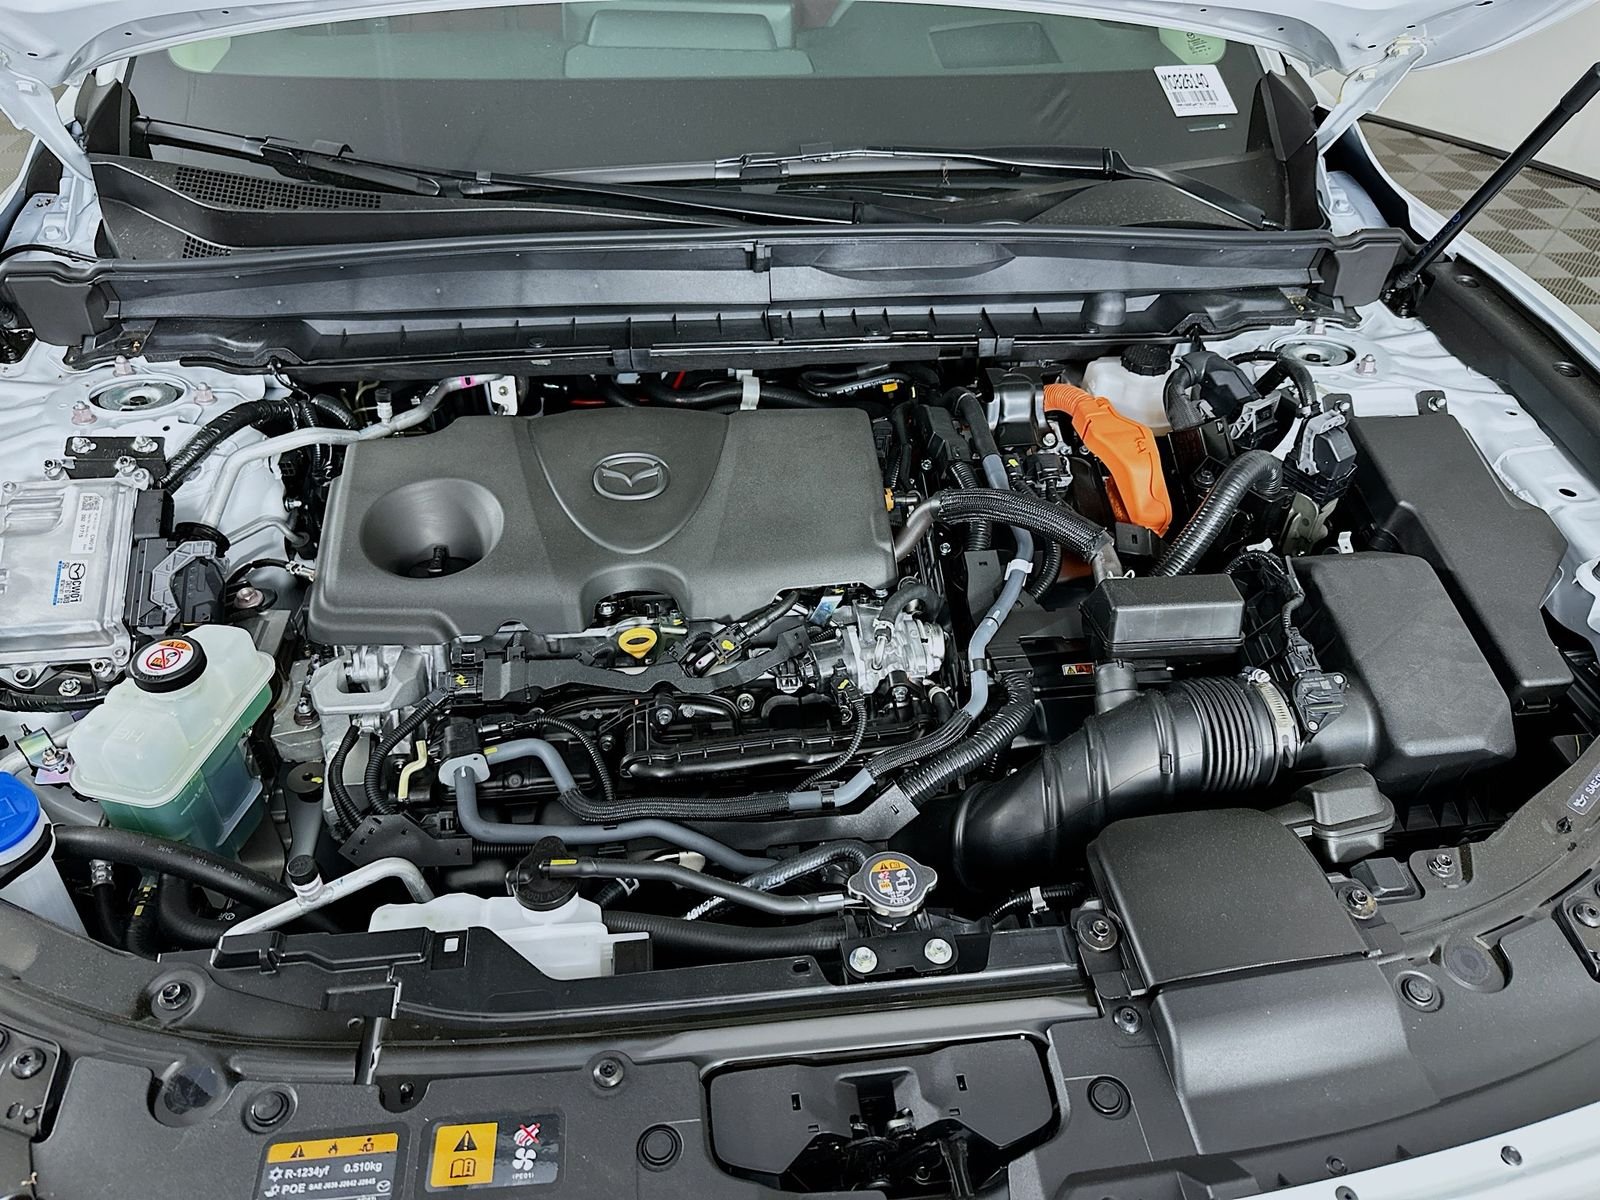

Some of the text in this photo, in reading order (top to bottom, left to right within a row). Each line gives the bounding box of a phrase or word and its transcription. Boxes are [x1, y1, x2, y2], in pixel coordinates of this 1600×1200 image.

[71, 580, 82, 603] CW01
[284, 1161, 383, 1179] R-1234yf 0.510kg
[281, 1183, 306, 1195] POE
